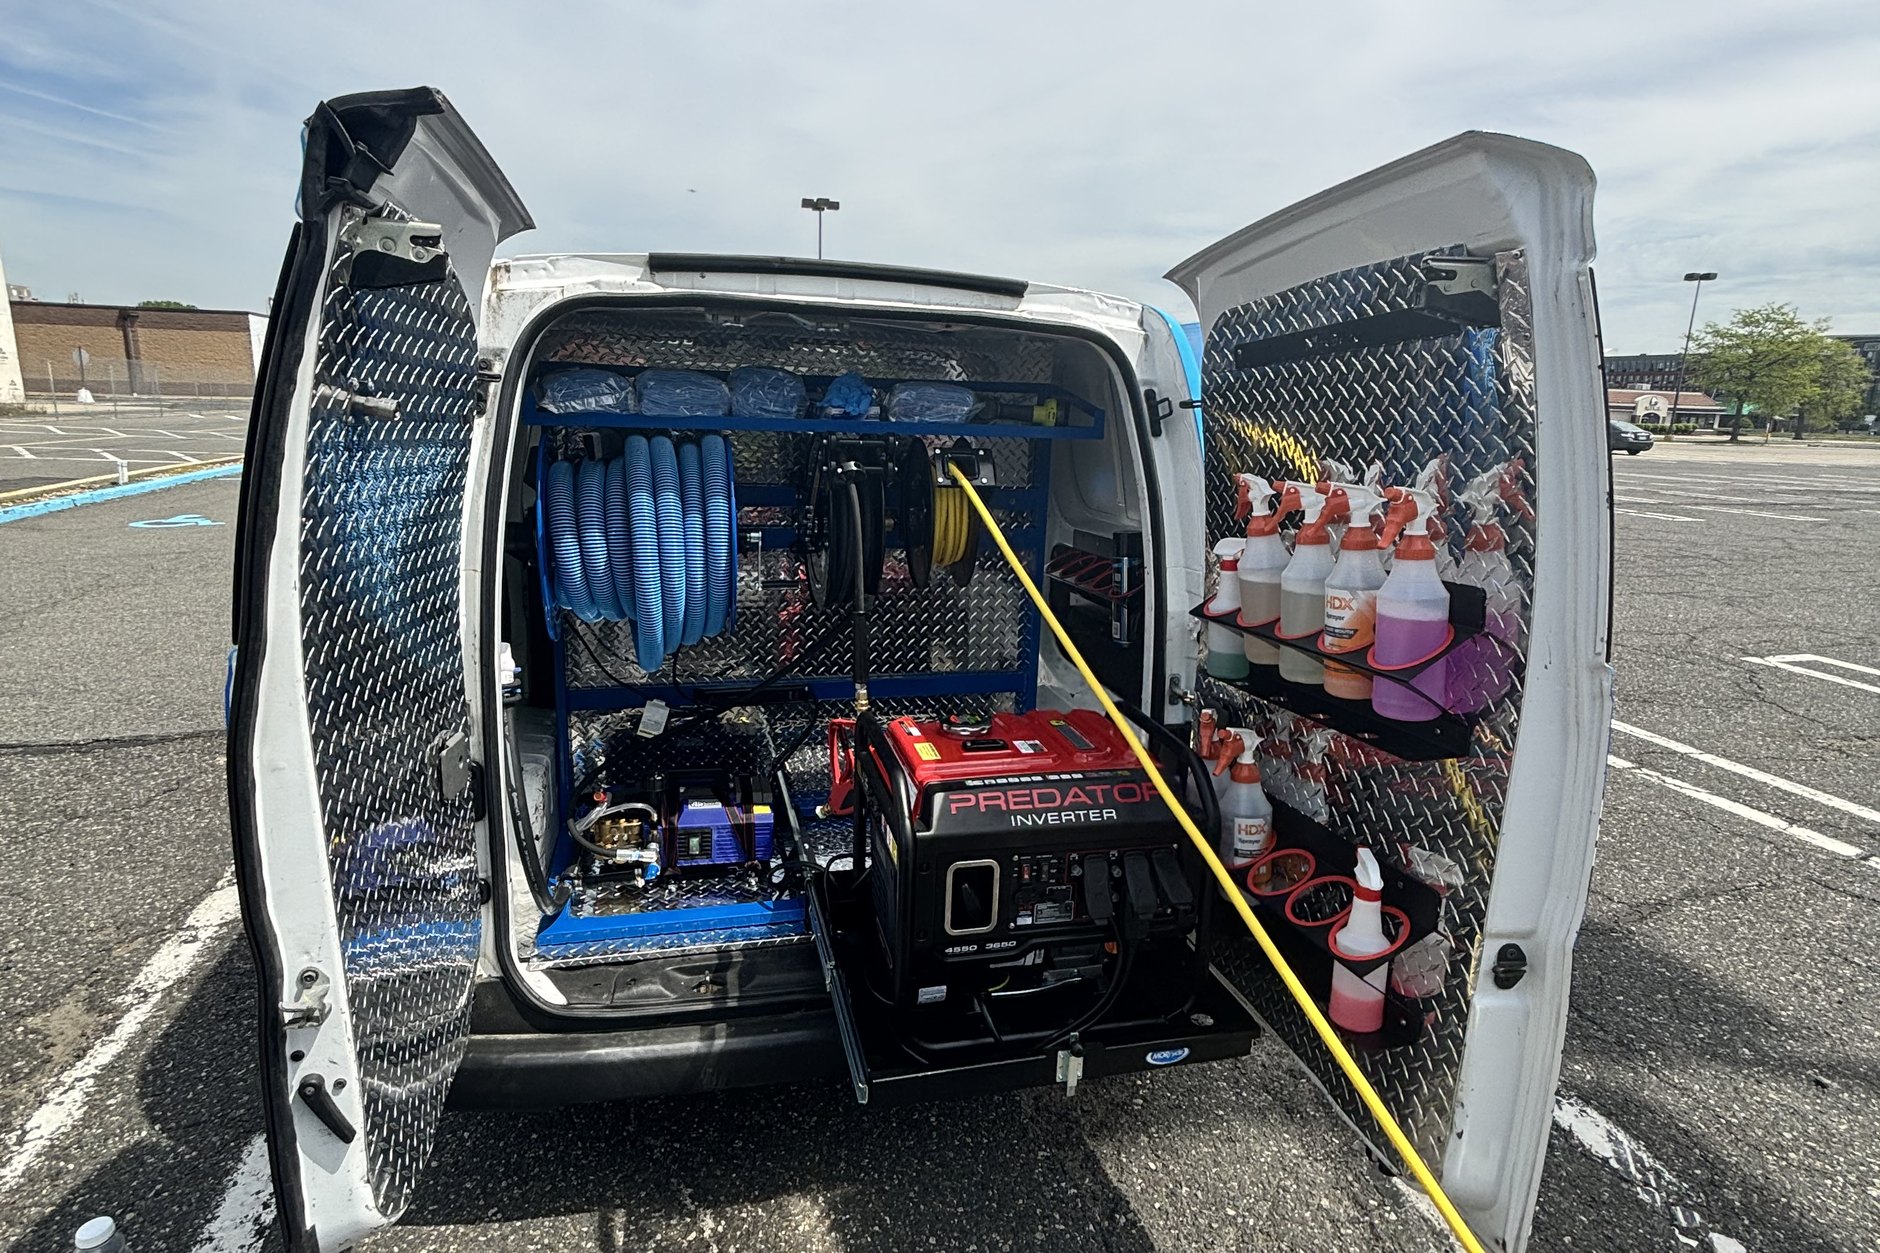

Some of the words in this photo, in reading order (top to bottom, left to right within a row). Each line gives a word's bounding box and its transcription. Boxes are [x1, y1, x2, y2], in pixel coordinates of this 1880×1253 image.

[1326, 595, 1354, 611] HDX
[1011, 809, 1117, 827] INVERTER
[1237, 823, 1266, 835] HDX
[945, 945, 978, 953] 4550
[985, 941, 1017, 950] 3650
